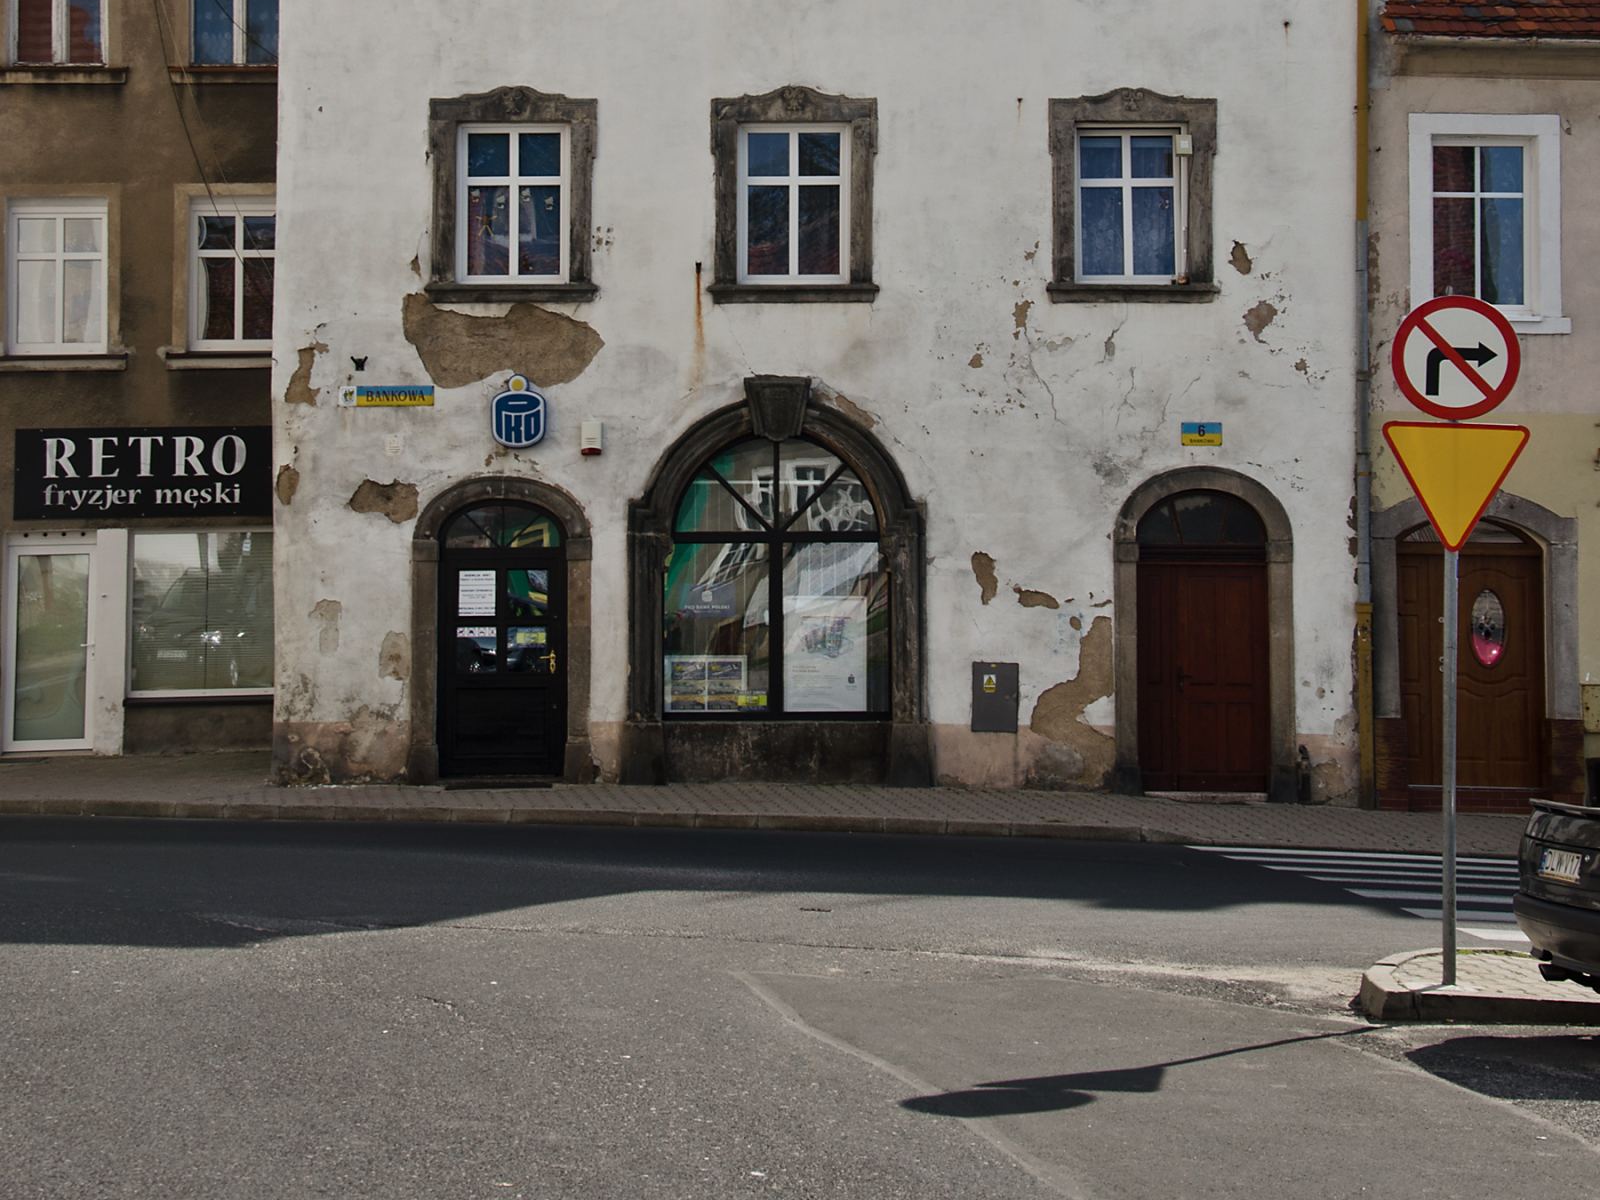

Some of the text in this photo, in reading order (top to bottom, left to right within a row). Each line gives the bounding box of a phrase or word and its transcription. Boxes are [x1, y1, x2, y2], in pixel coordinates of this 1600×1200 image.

[366, 390, 425, 402] BANKOWA
[1198, 424, 1206, 437] 6
[43, 435, 247, 479] RETRO
[43, 482, 241, 511] fryzjer męski
